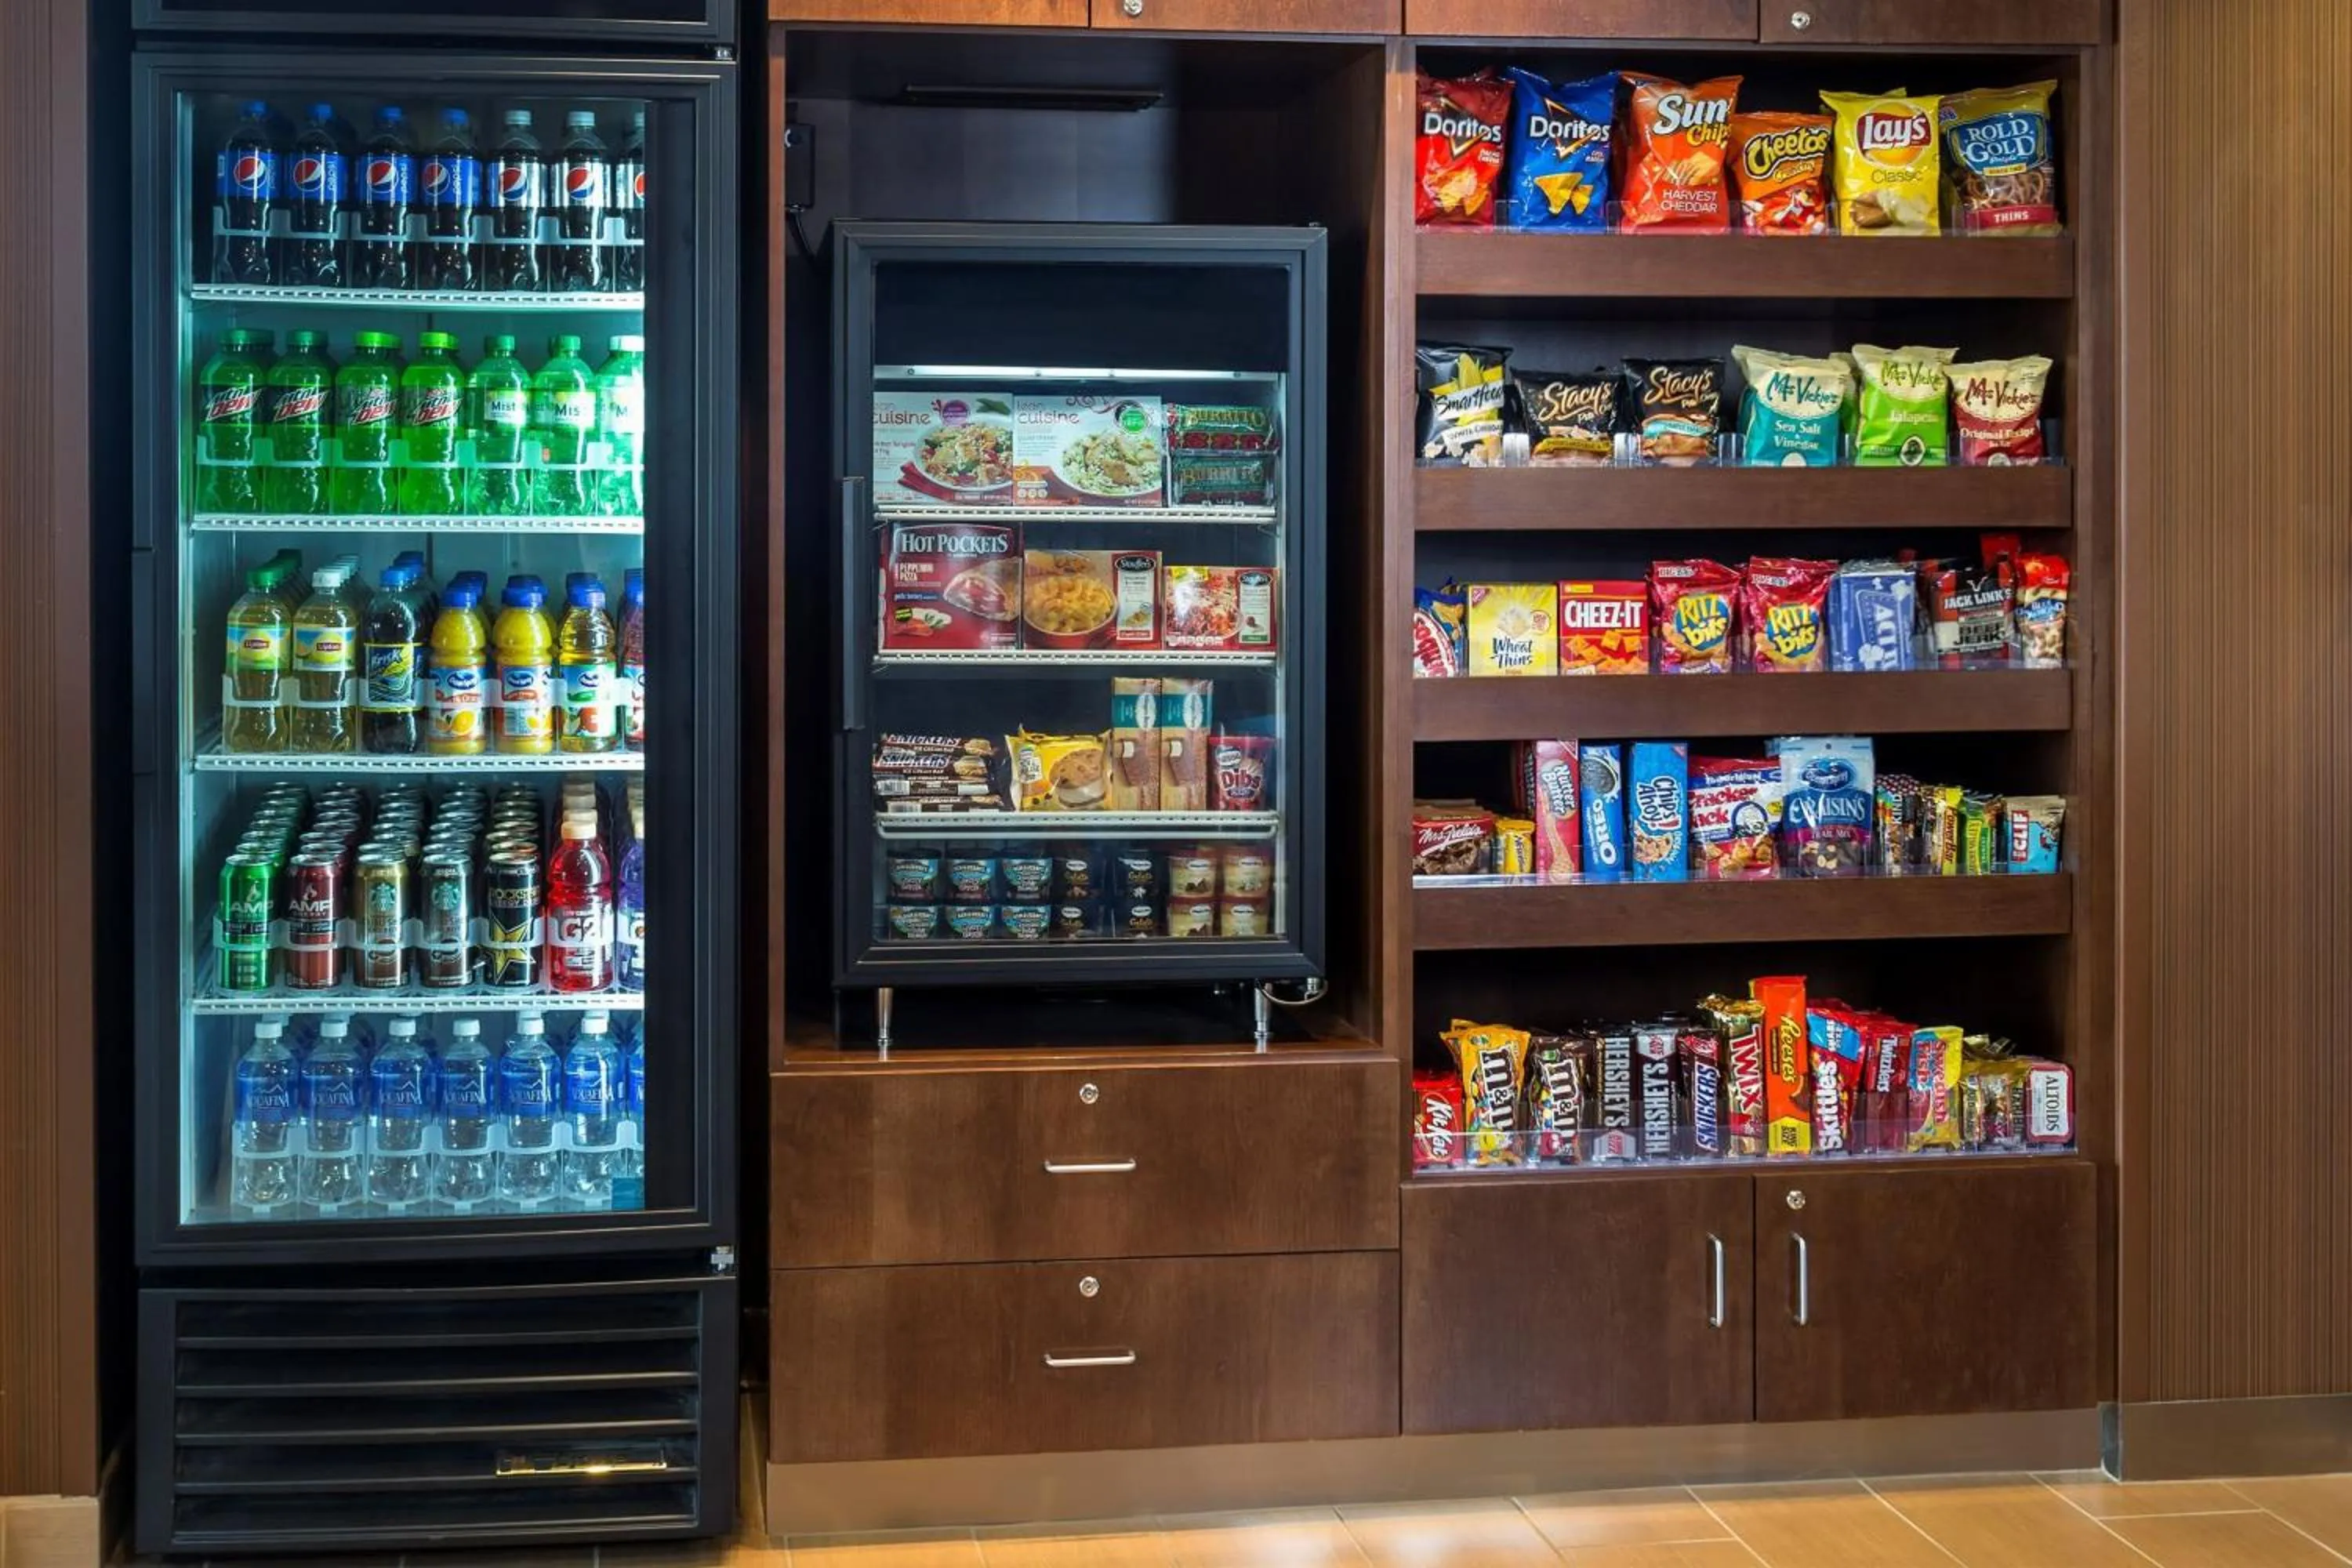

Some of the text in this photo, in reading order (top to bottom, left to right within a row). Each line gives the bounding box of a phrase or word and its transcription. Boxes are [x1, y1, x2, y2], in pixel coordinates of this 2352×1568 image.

[1425, 112, 1502, 143] Doritos
[1530, 115, 1612, 142] Doritos
[1653, 94, 1726, 133] Sun
[1863, 113, 1926, 150] Lay's
[1967, 118, 2029, 143] ROLD
[1745, 129, 1829, 179] Cheetos
[1966, 135, 2036, 163] GOLD
[1871, 169, 1923, 185] Classic
[1661, 201, 1718, 214] CHEDDAR
[1662, 190, 1718, 201] HARVEST
[1994, 210, 2030, 223] THINS
[1538, 381, 1612, 421] Stacy's
[1644, 366, 1714, 405] Stacy's
[491, 401, 516, 412] Mist
[1018, 412, 1080, 424] cuisine
[902, 534, 1008, 554] HOT POCKETS
[1565, 600, 1643, 628] CHEEZ-IT
[1677, 593, 1722, 626] RITZ
[1767, 604, 1812, 634] RITZ
[1492, 636, 1533, 653] Wheat
[1490, 653, 1534, 669] Thins
[1221, 768, 1261, 789] Dibs
[1544, 772, 1566, 816] Butter
[1555, 763, 1576, 808] Nutter
[1653, 778, 1676, 823] Chips
[1892, 793, 1903, 825] KIND
[1592, 799, 1617, 865] OREO
[2012, 812, 2029, 852] CLIF
[230, 900, 274, 913] AMP
[289, 900, 332, 912] AMP
[1780, 1015, 1802, 1083] Reese's
[1878, 1034, 1897, 1093] Twizzlers
[1605, 1037, 1630, 1127] HERSHEY'S
[1730, 1025, 1762, 1112] TWIX
[1933, 1040, 1949, 1123] Swedish
[1642, 1062, 1671, 1152] HERSHEY'S
[1695, 1063, 1718, 1151] SNICKERS
[2045, 1075, 2060, 1132] ALTOIDS
